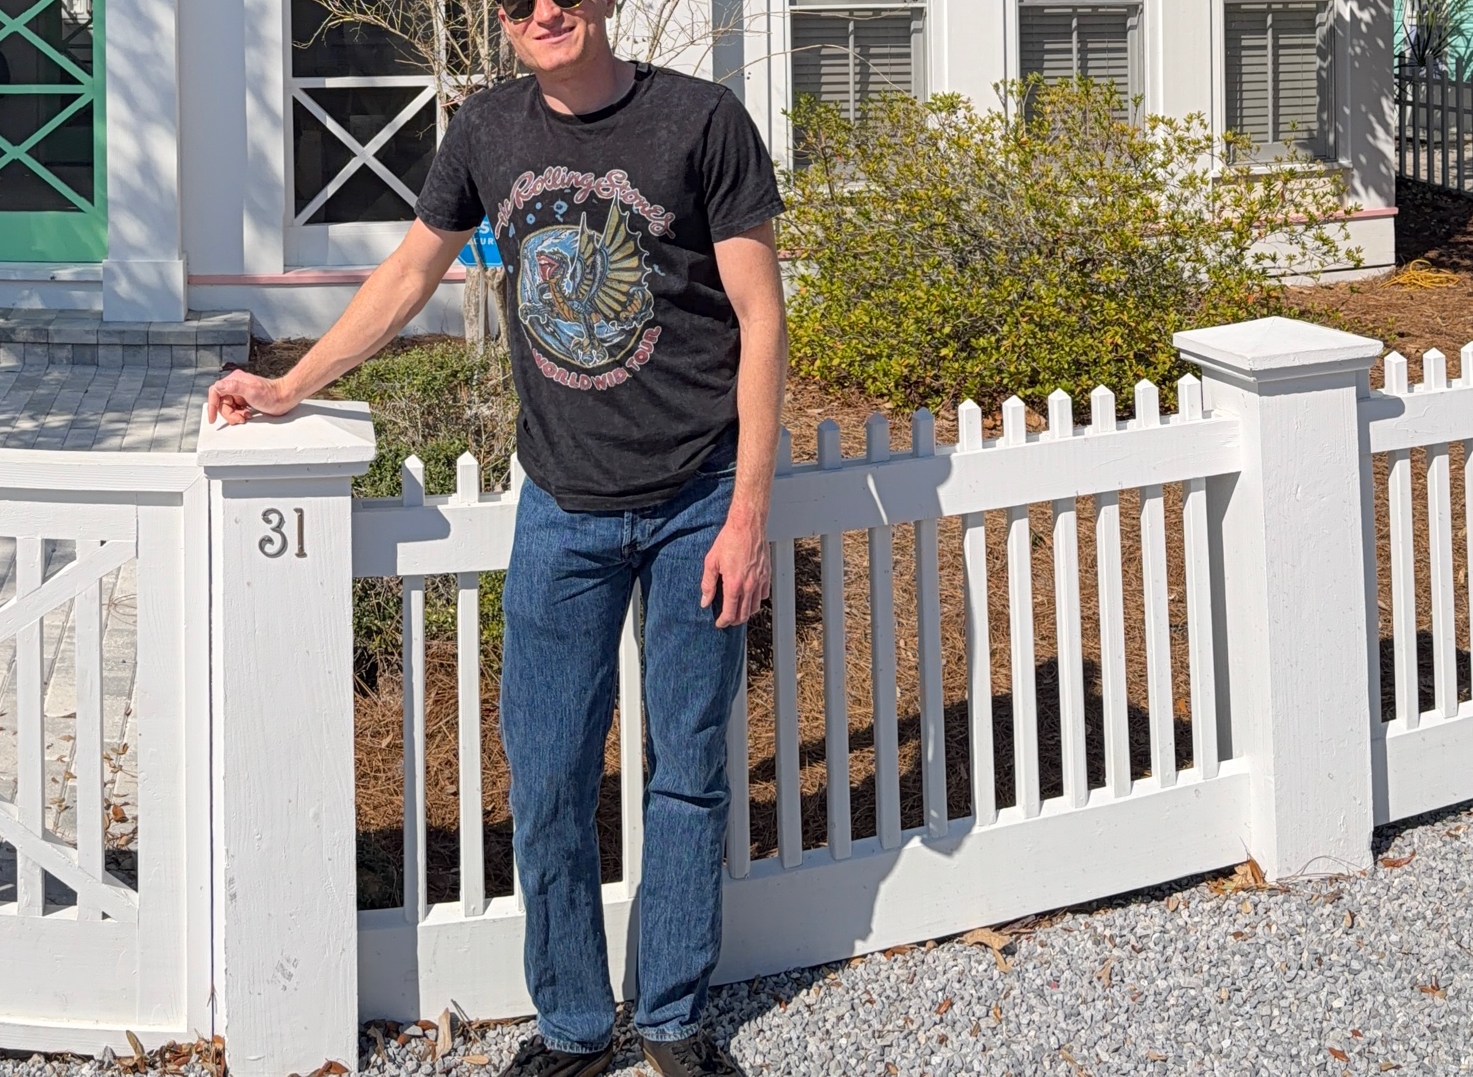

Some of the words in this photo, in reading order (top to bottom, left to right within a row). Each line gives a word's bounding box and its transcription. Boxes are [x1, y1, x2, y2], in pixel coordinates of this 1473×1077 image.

[510, 166, 595, 210] Rolling
[594, 169, 676, 239] Stones
[531, 347, 592, 390] WORLD
[592, 367, 633, 391] WID
[626, 326, 662, 371] TOUR
[258, 507, 308, 559] 31
